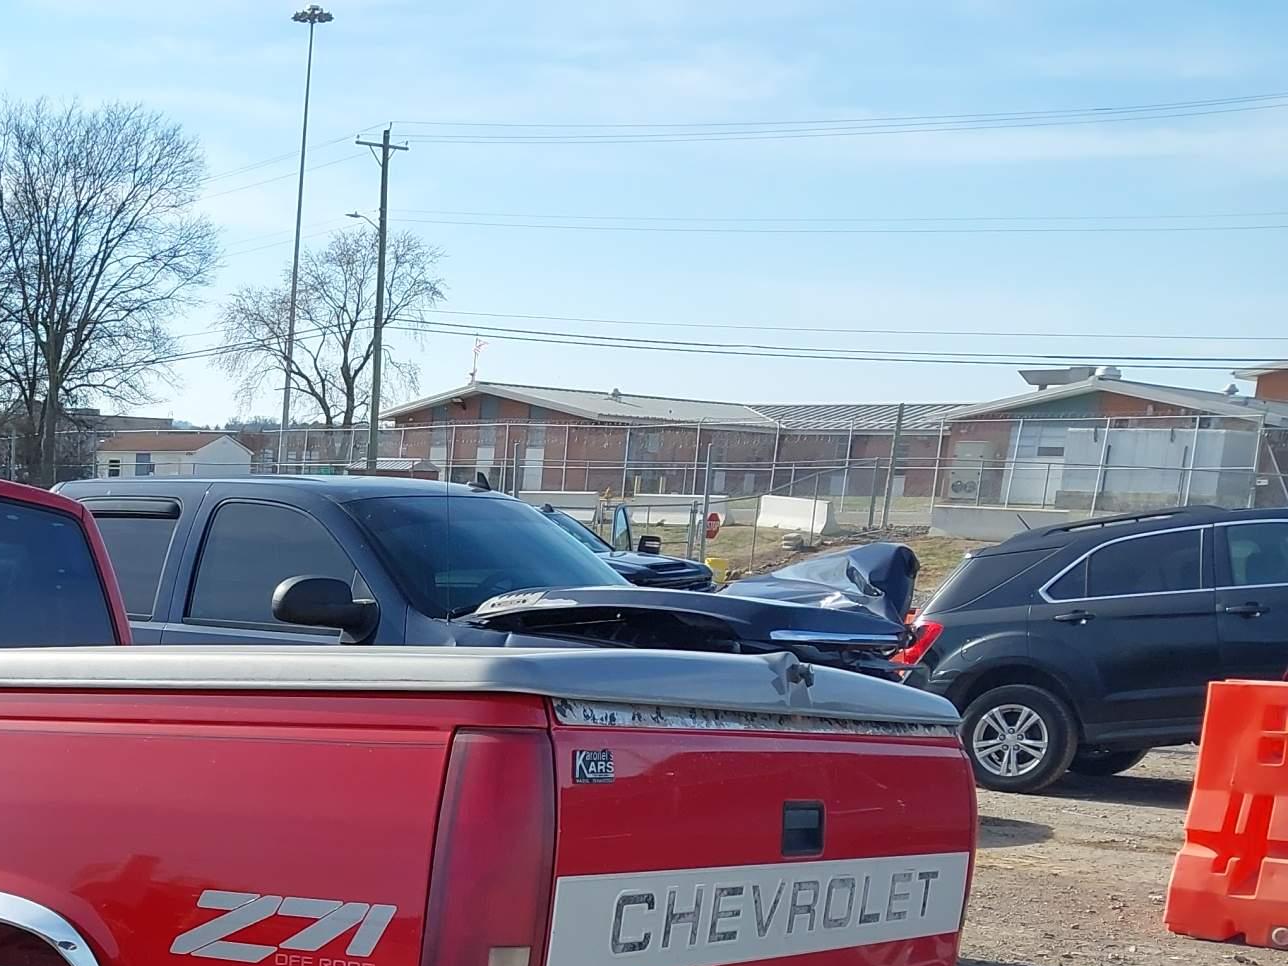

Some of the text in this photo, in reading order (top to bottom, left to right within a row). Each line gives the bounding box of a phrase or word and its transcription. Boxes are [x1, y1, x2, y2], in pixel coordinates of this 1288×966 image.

[576, 751, 615, 778] KARS
[169, 889, 398, 964] Z71
[610, 870, 939, 954] CHEVROLET
